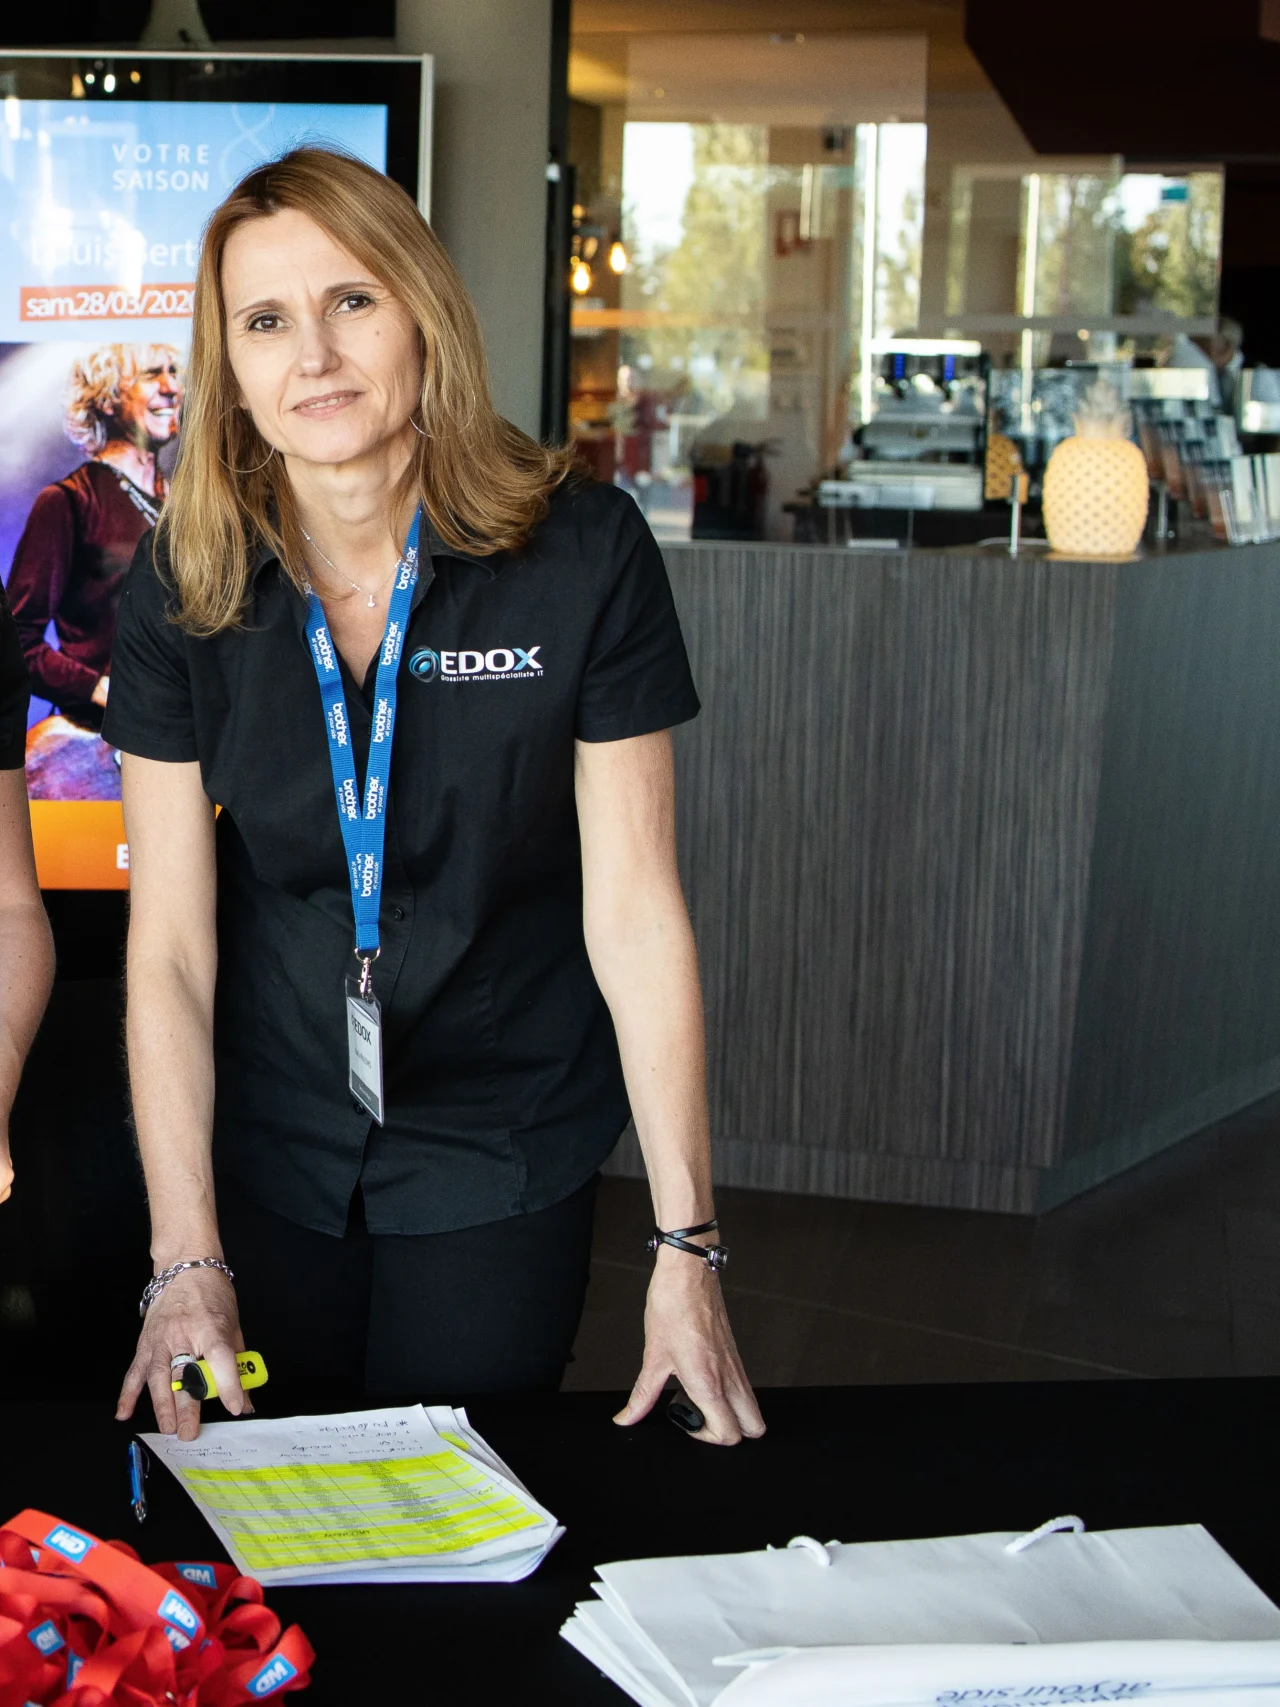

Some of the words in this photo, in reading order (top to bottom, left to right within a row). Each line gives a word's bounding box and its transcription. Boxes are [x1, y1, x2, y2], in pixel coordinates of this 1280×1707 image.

[111, 143, 210, 165] VOTRE
[112, 169, 209, 191] SAISON
[440, 646, 543, 675] EDOX
[355, 1021, 372, 1046] EDOX
[182, 1567, 213, 1583] WD
[255, 1660, 289, 1694] WD
